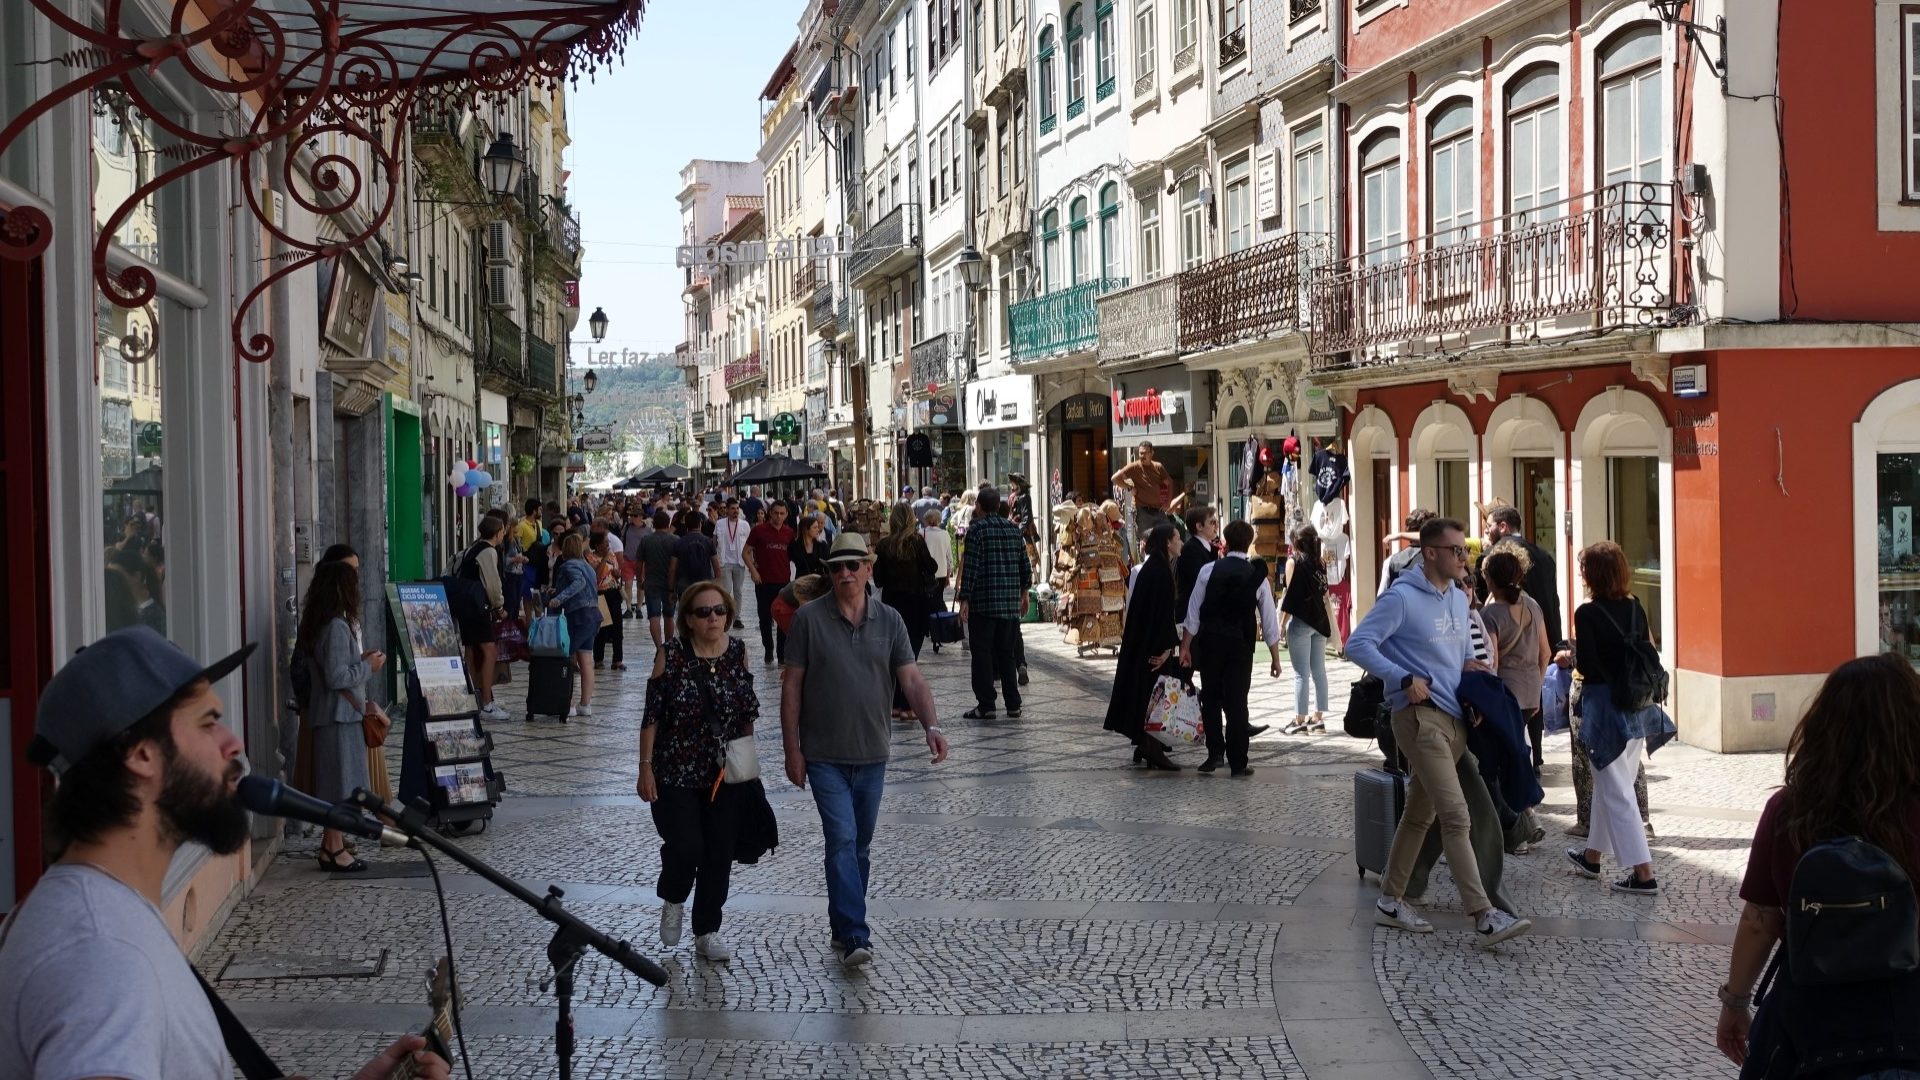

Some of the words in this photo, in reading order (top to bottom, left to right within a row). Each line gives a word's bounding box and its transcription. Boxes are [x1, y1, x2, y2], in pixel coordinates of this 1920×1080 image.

[588, 347, 617, 365] Ler
[622, 347, 648, 365] faz
[1065, 402, 1084, 421] Captain
[1089, 400, 1104, 417] Porto
